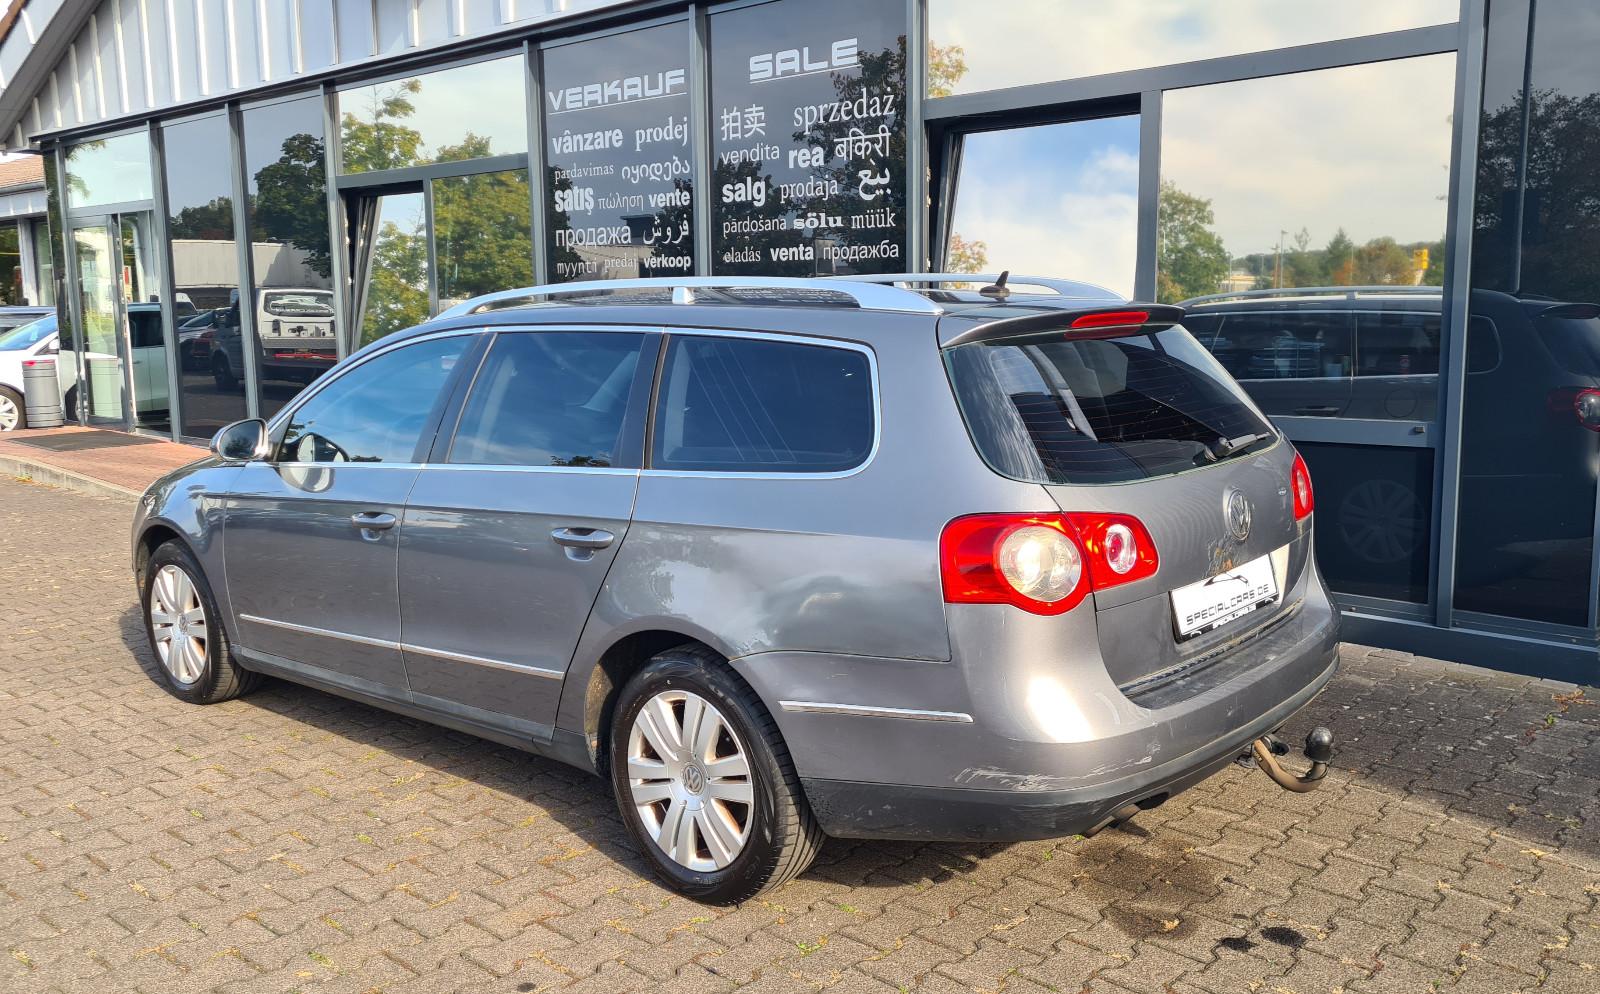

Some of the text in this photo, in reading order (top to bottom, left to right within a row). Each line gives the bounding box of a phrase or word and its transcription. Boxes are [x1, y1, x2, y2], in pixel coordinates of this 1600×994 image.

[749, 37, 858, 81] SALE
[549, 68, 685, 111] VERKAUF
[720, 103, 767, 141] 拍卖
[793, 86, 896, 135] sprzedaż
[552, 116, 688, 154] vânzare prodej
[621, 154, 690, 184] იყიდება
[720, 142, 825, 169] vendita rea
[554, 163, 615, 184] pardavimas
[858, 167, 892, 201] بيع
[554, 186, 595, 215] satış
[597, 192, 645, 213] πώληση
[648, 188, 691, 208] vente
[722, 175, 839, 207] salg prodaja
[723, 207, 896, 239] pārdošana sölu müük
[555, 225, 632, 252] продажа
[723, 243, 814, 263] eladás venta
[823, 240, 899, 264] продажба
[557, 252, 691, 277] myynti predaj verkoop
